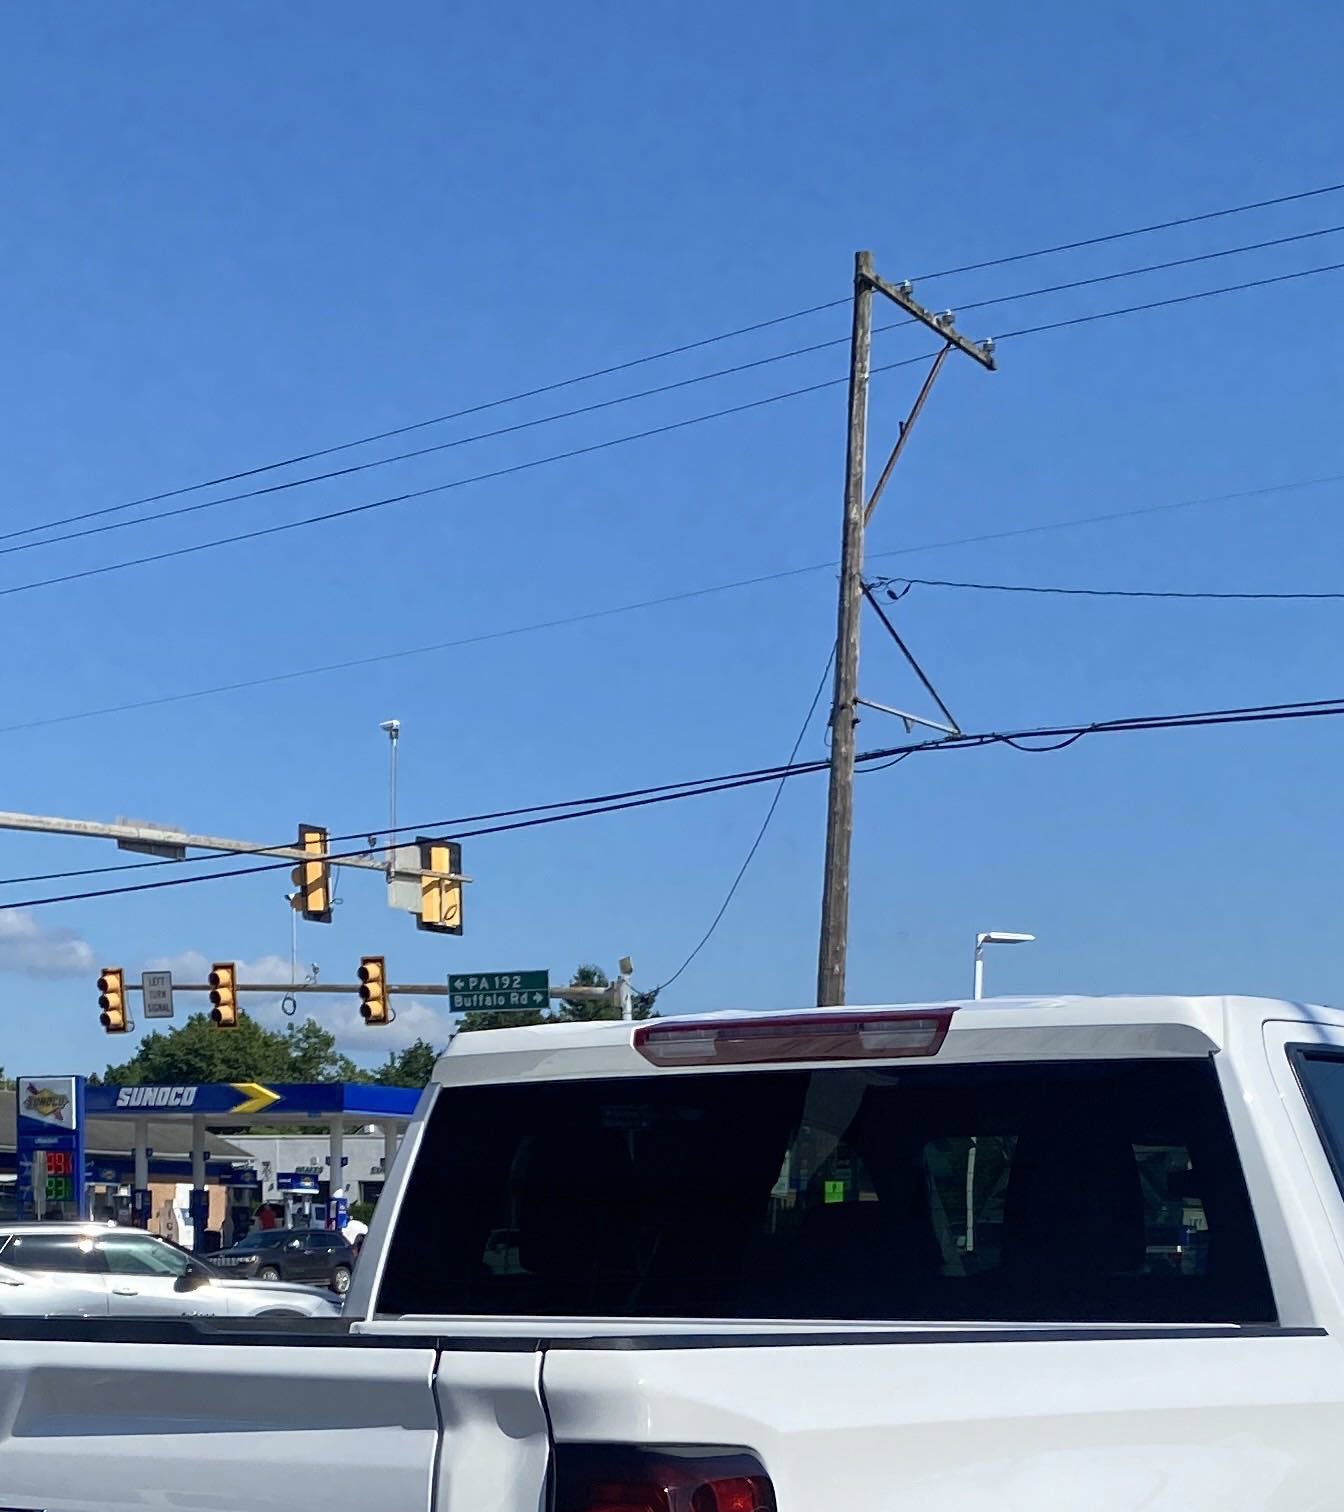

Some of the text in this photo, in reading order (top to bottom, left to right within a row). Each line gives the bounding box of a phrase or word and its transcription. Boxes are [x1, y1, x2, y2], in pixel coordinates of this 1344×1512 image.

[468, 976, 521, 990] PA 192
[454, 992, 529, 1008] Buffalo Rd
[116, 1086, 199, 1107] SUNOCO
